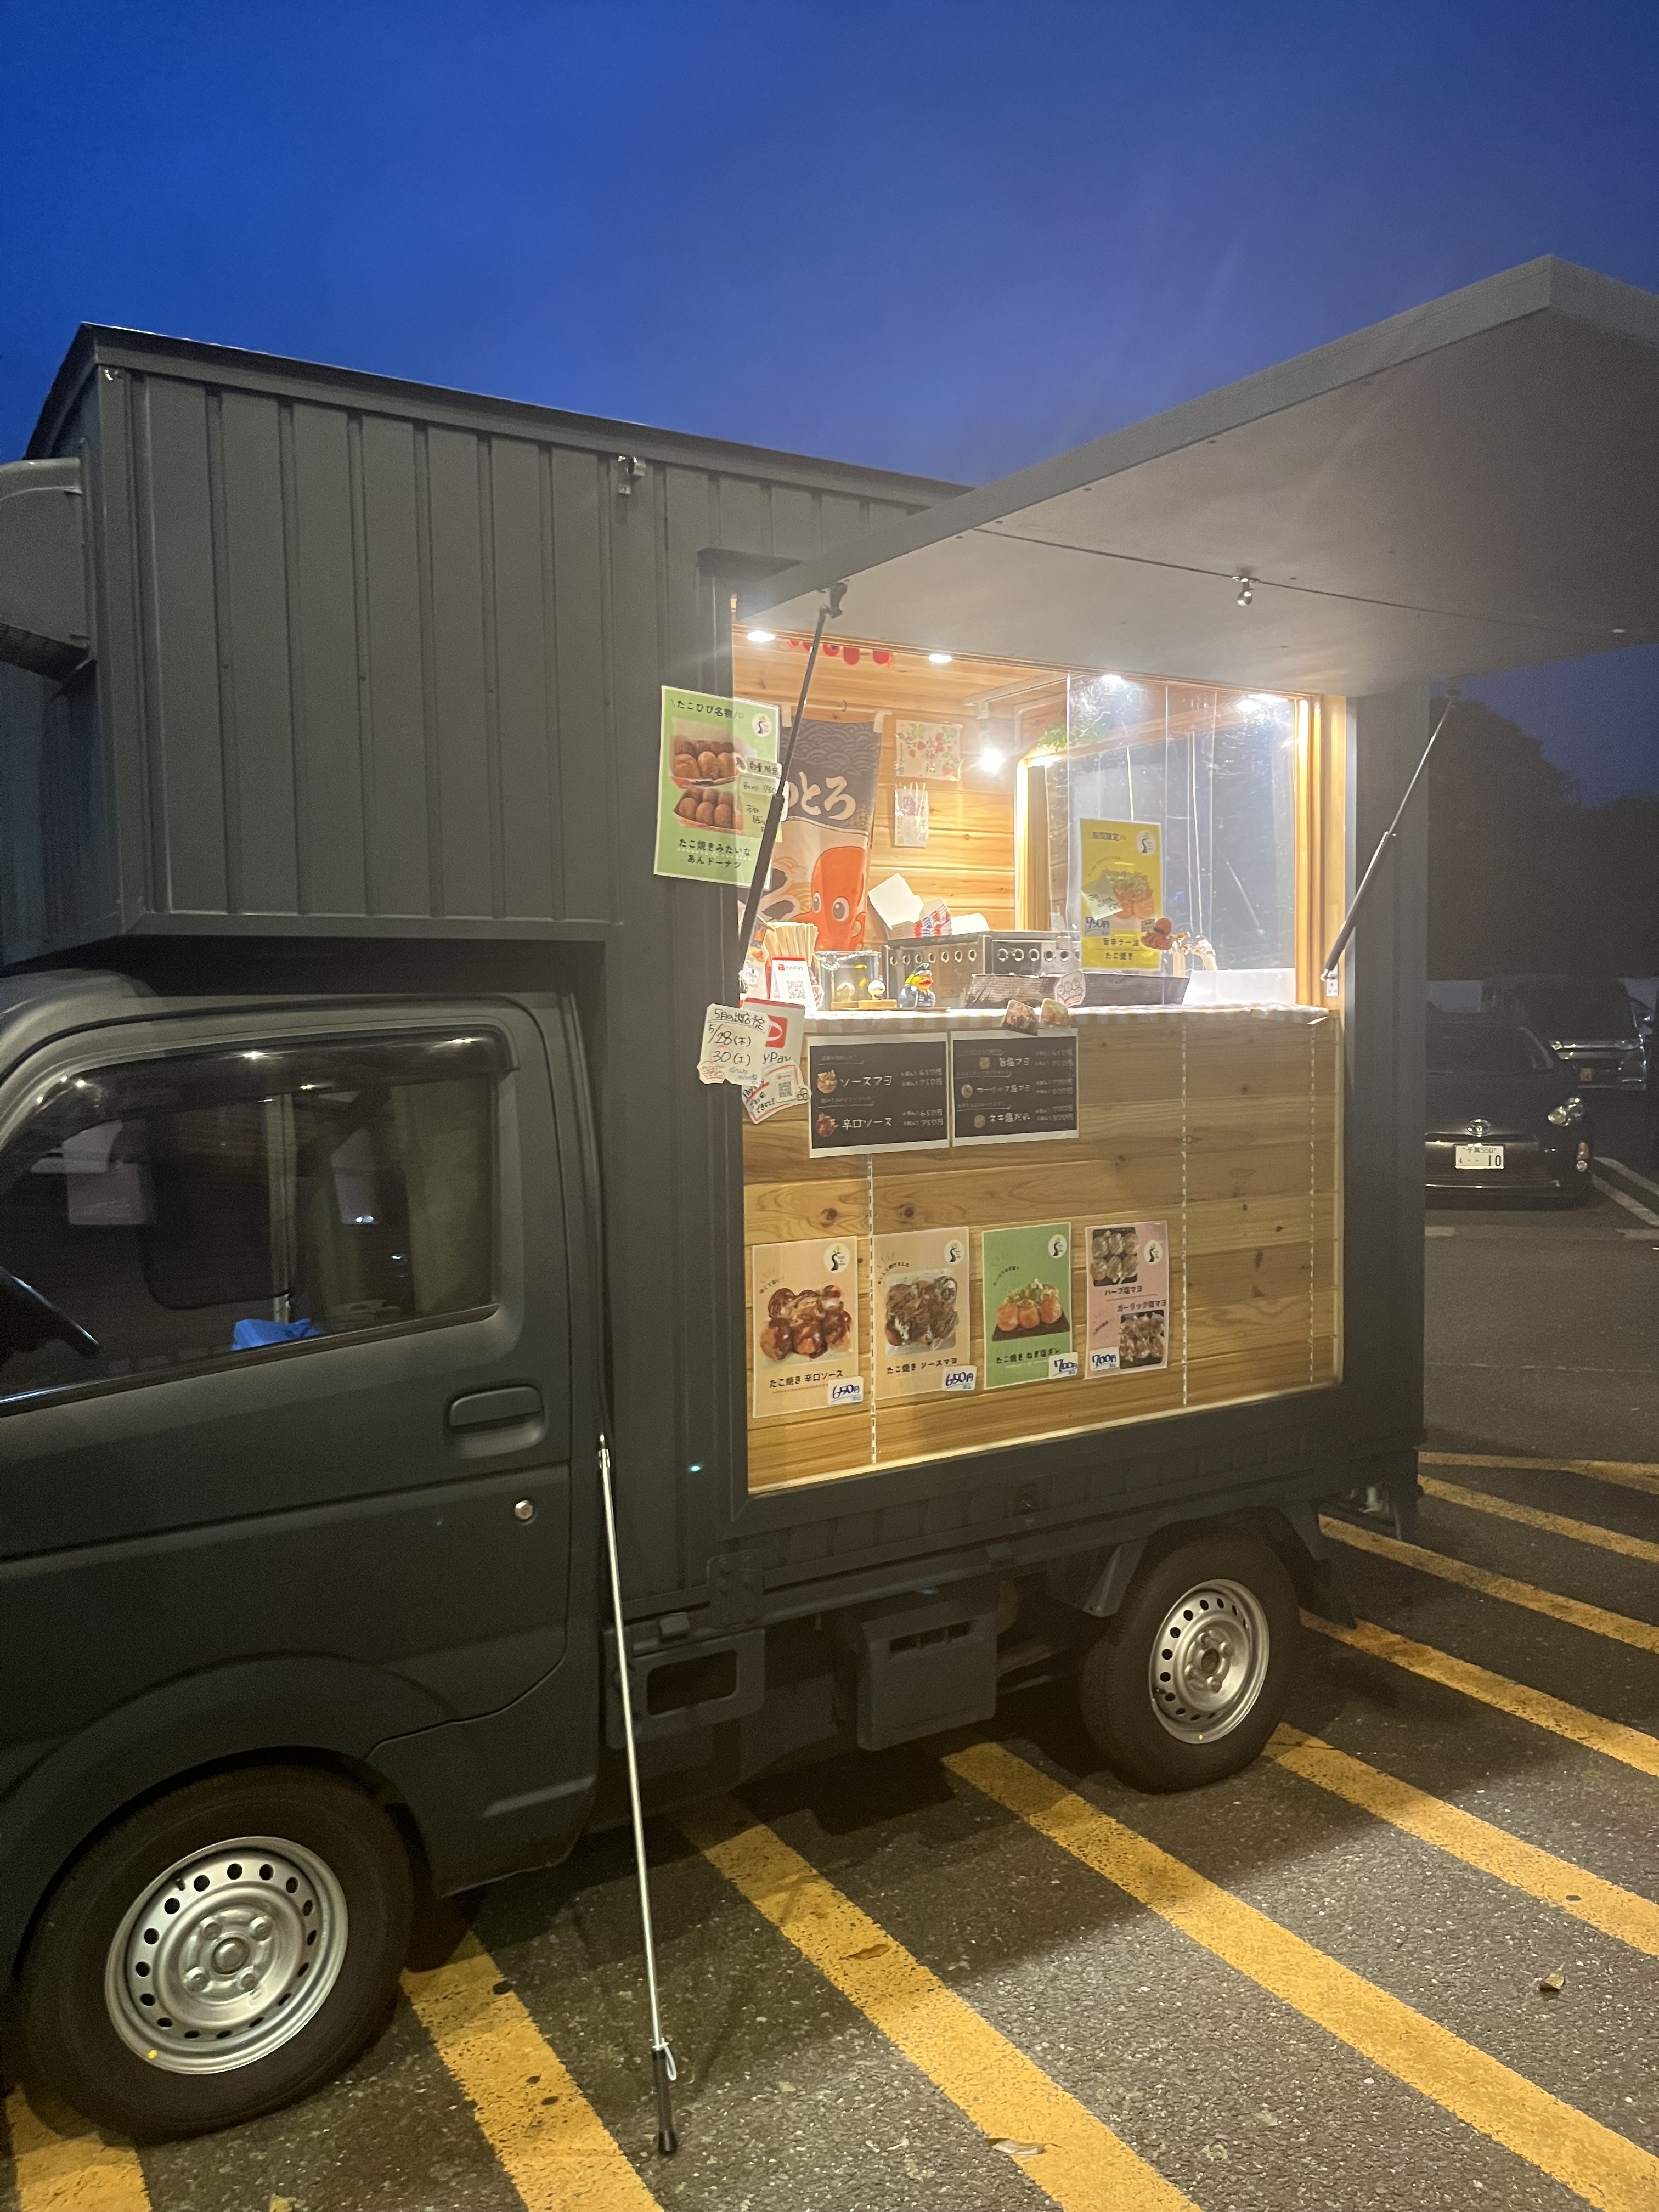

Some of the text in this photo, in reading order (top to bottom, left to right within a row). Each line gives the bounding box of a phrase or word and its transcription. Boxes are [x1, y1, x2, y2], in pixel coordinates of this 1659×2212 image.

[679, 839, 752, 856] たこ焼きみたいな
[840, 1076, 893, 1087] ソースマヨ
[842, 1118, 893, 1130] 辛口ソース
[887, 1357, 957, 1375] たこ焼き ソースマヨ
[996, 1353, 1023, 1364] たこ焼き
[769, 1370, 844, 1389] たこ焼き 辛口ソース
[945, 1372, 974, 1386] 650円
[832, 1384, 860, 1400] 650円
